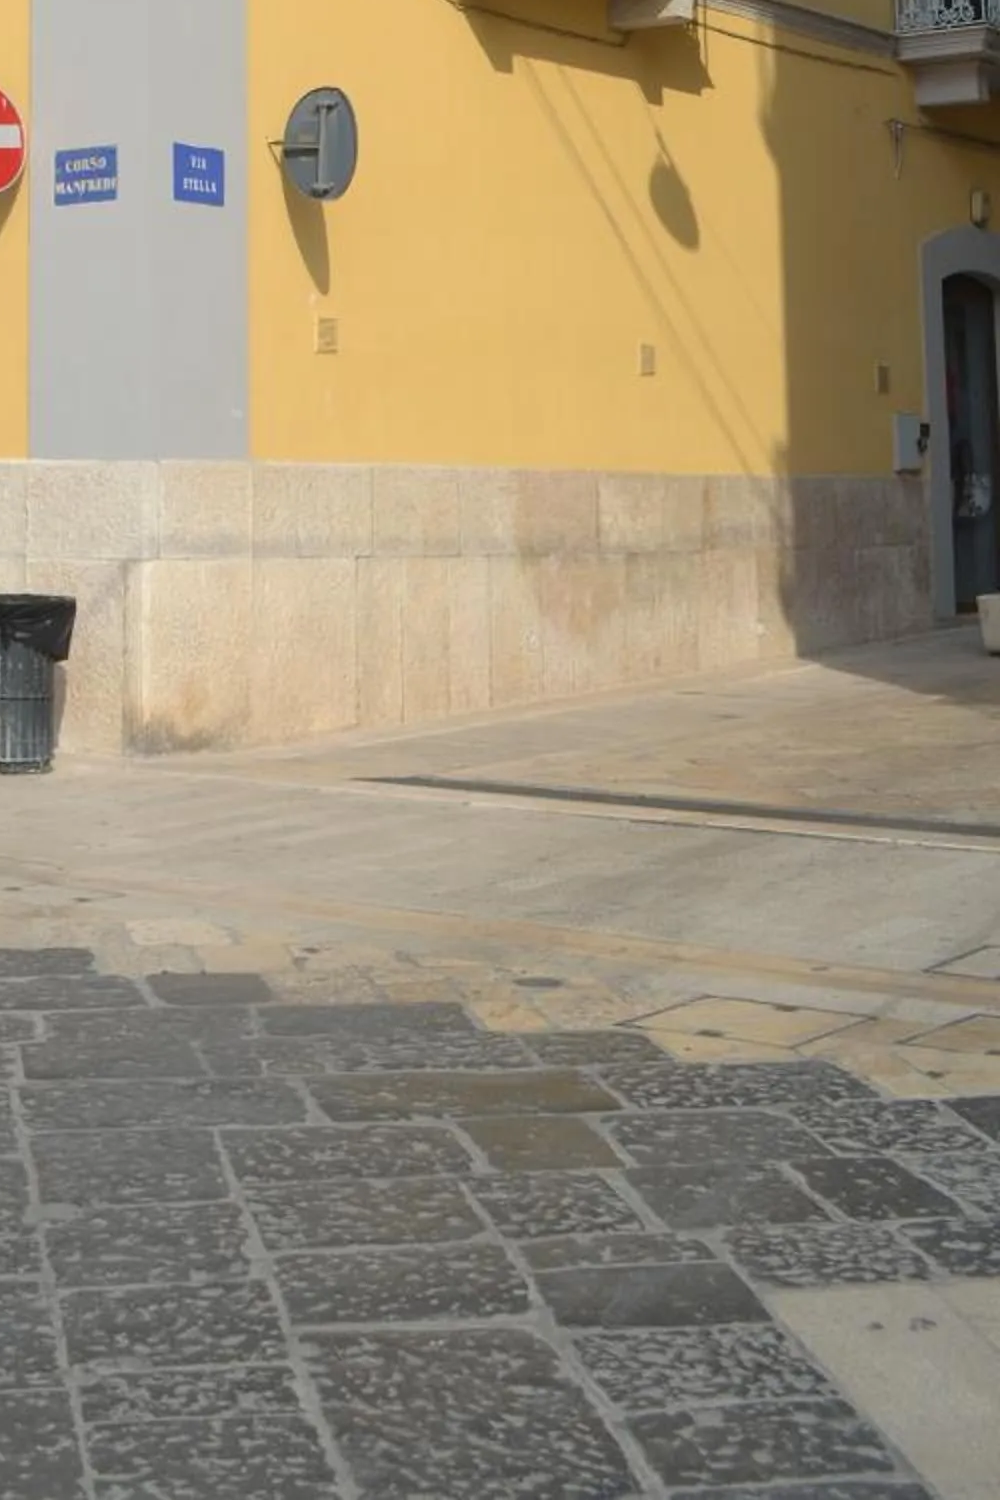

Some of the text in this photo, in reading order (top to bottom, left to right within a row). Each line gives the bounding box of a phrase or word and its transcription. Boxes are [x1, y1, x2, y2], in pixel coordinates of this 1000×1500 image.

[65, 156, 106, 173] CORSO
[190, 155, 206, 170] VIA
[183, 178, 216, 193] STELLA
